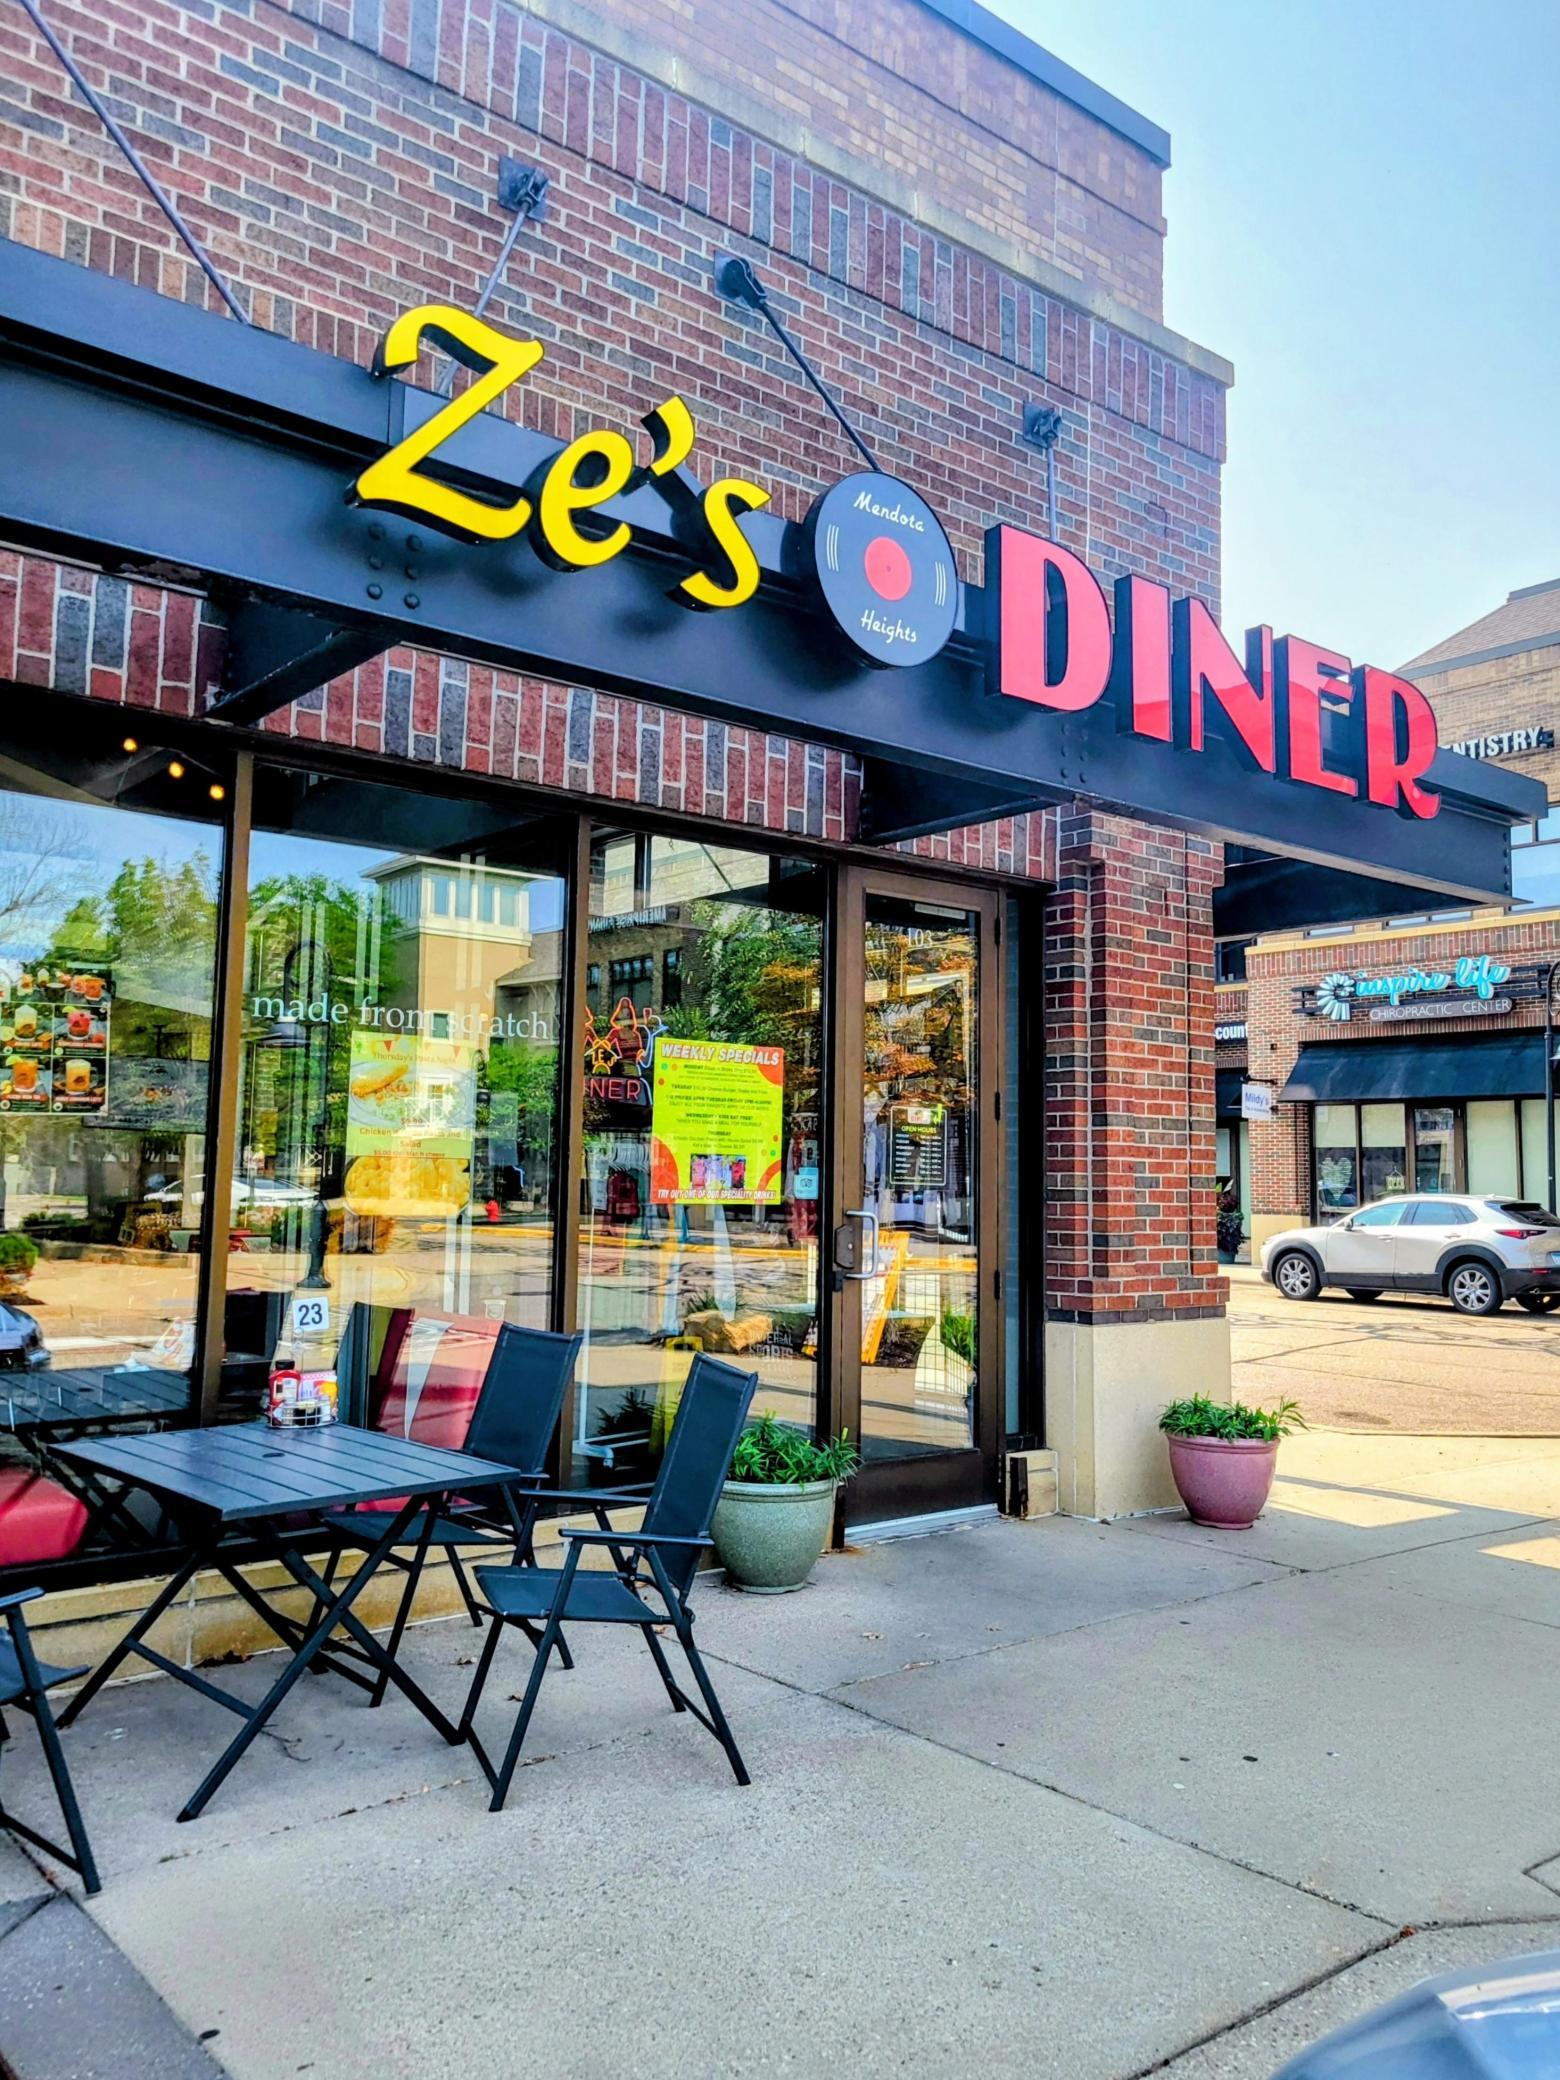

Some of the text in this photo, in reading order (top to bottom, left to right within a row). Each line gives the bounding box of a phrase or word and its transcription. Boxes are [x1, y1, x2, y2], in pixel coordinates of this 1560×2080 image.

[354, 303, 773, 607] Ze's
[852, 490, 925, 533] Mendota
[860, 609, 917, 644] Heights
[997, 521, 1441, 820] DINER
[1438, 726, 1540, 759] NTISTRY
[1355, 954, 1511, 1006] inspire life
[252, 992, 549, 1041] made from scratch
[1369, 998, 1511, 1021] CHIROPRACTIC CENTER
[661, 1042, 780, 1066] WEEKLY SPECIALS
[590, 1077, 641, 1101] NER
[298, 1303, 323, 1327] 23
